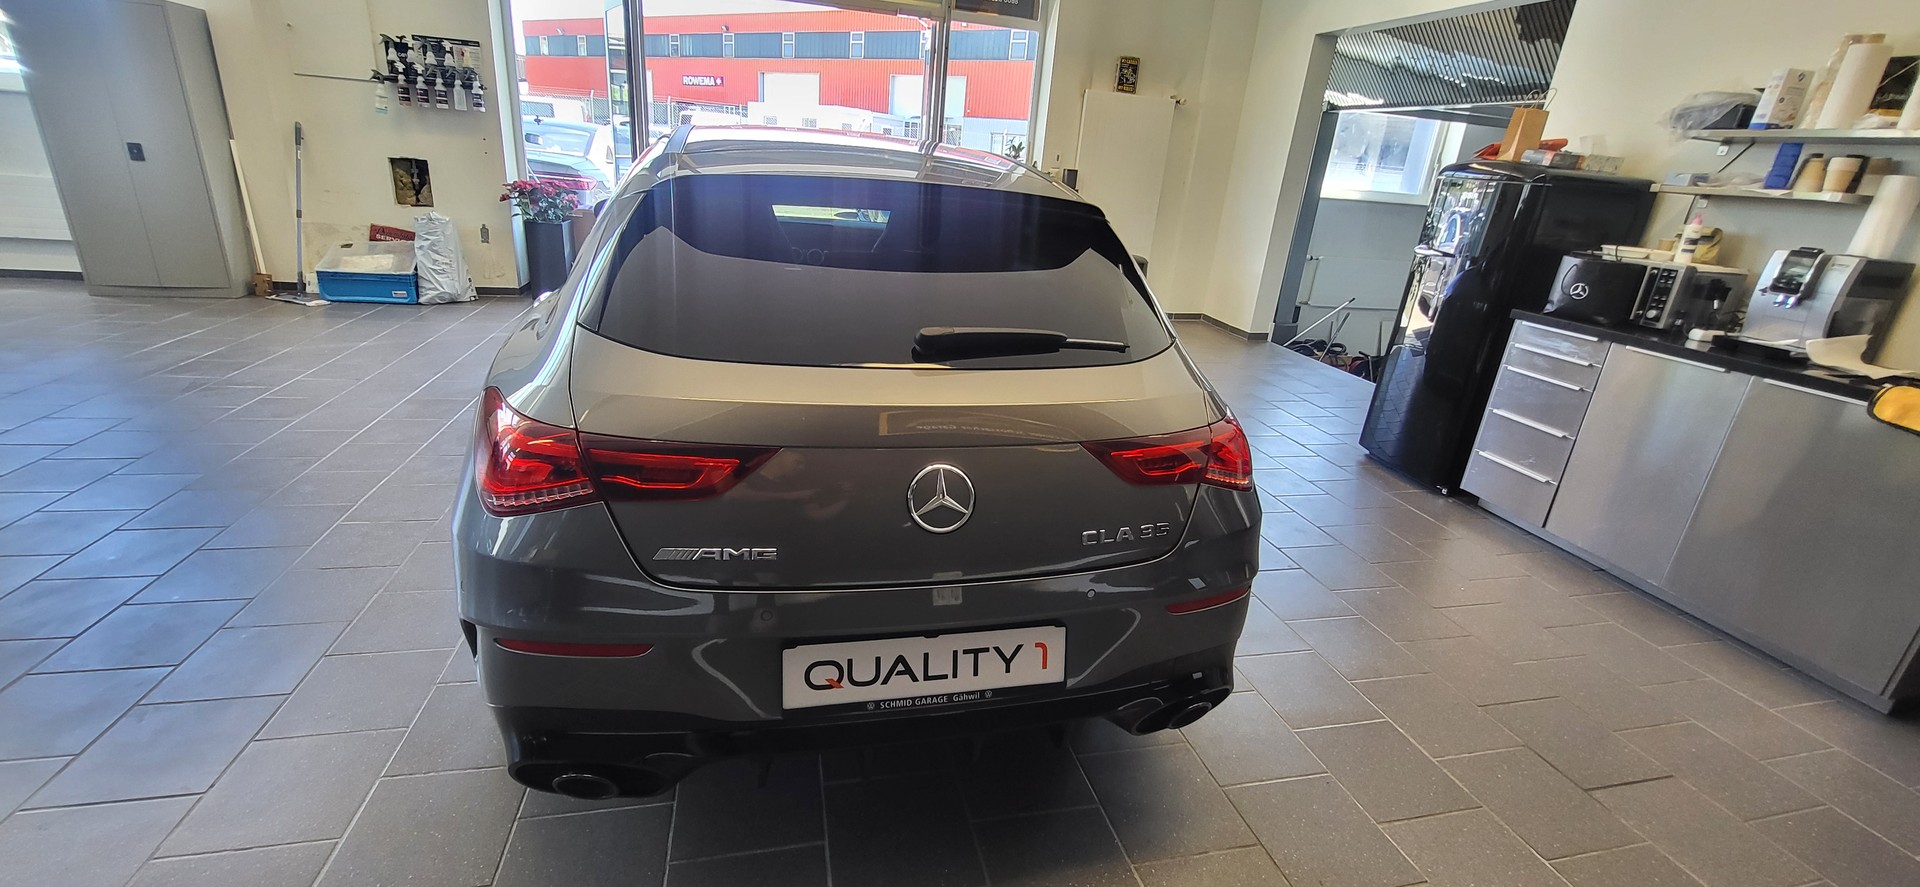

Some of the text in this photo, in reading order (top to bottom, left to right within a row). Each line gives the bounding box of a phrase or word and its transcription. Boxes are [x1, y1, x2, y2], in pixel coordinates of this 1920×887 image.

[683, 75, 716, 86] ROWEMA
[1081, 522, 1170, 545] CLA 35
[692, 548, 777, 560] AMG
[803, 641, 1048, 691] QUALITY 1
[880, 691, 980, 709] SCHMID GARAGE Gähwil
